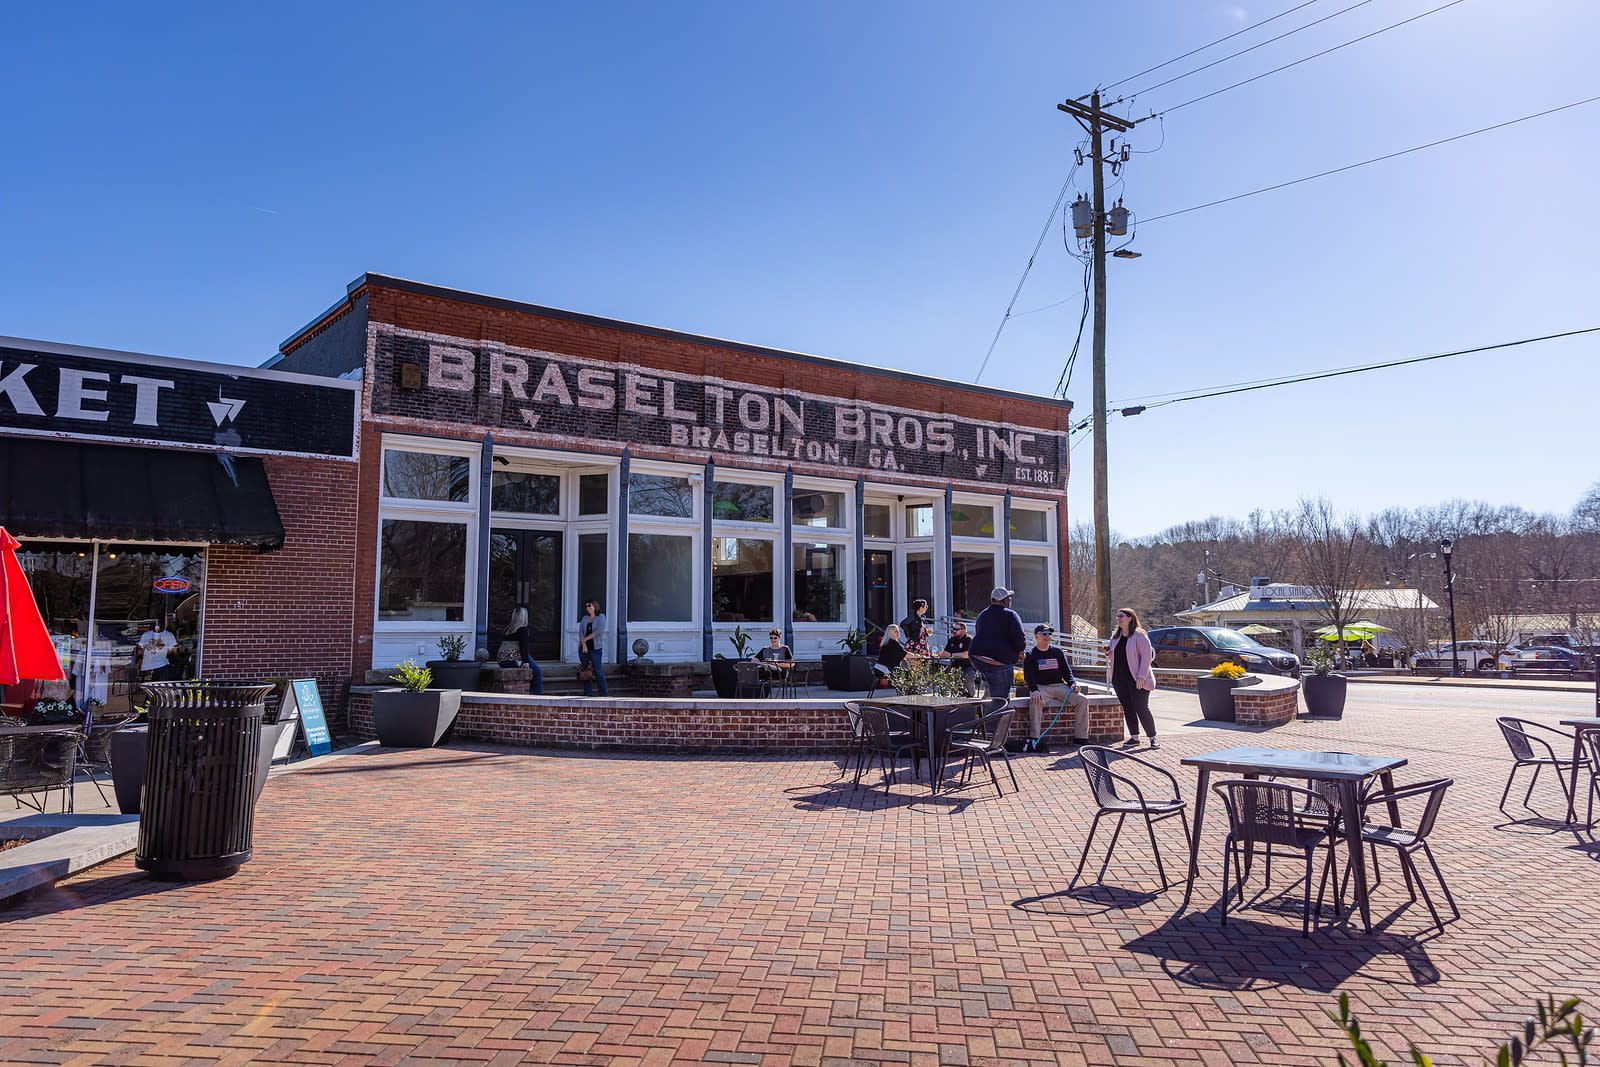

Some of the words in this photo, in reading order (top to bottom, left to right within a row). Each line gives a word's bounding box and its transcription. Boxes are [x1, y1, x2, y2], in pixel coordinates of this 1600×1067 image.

[428, 344, 805, 436] BRASELTON
[976, 427, 1044, 465] INC.
[868, 448, 905, 472] GA.
[1033, 469, 1054, 484] 1887
[153, 579, 190, 590] OPEN
[1262, 586, 1286, 597] LOCAL
